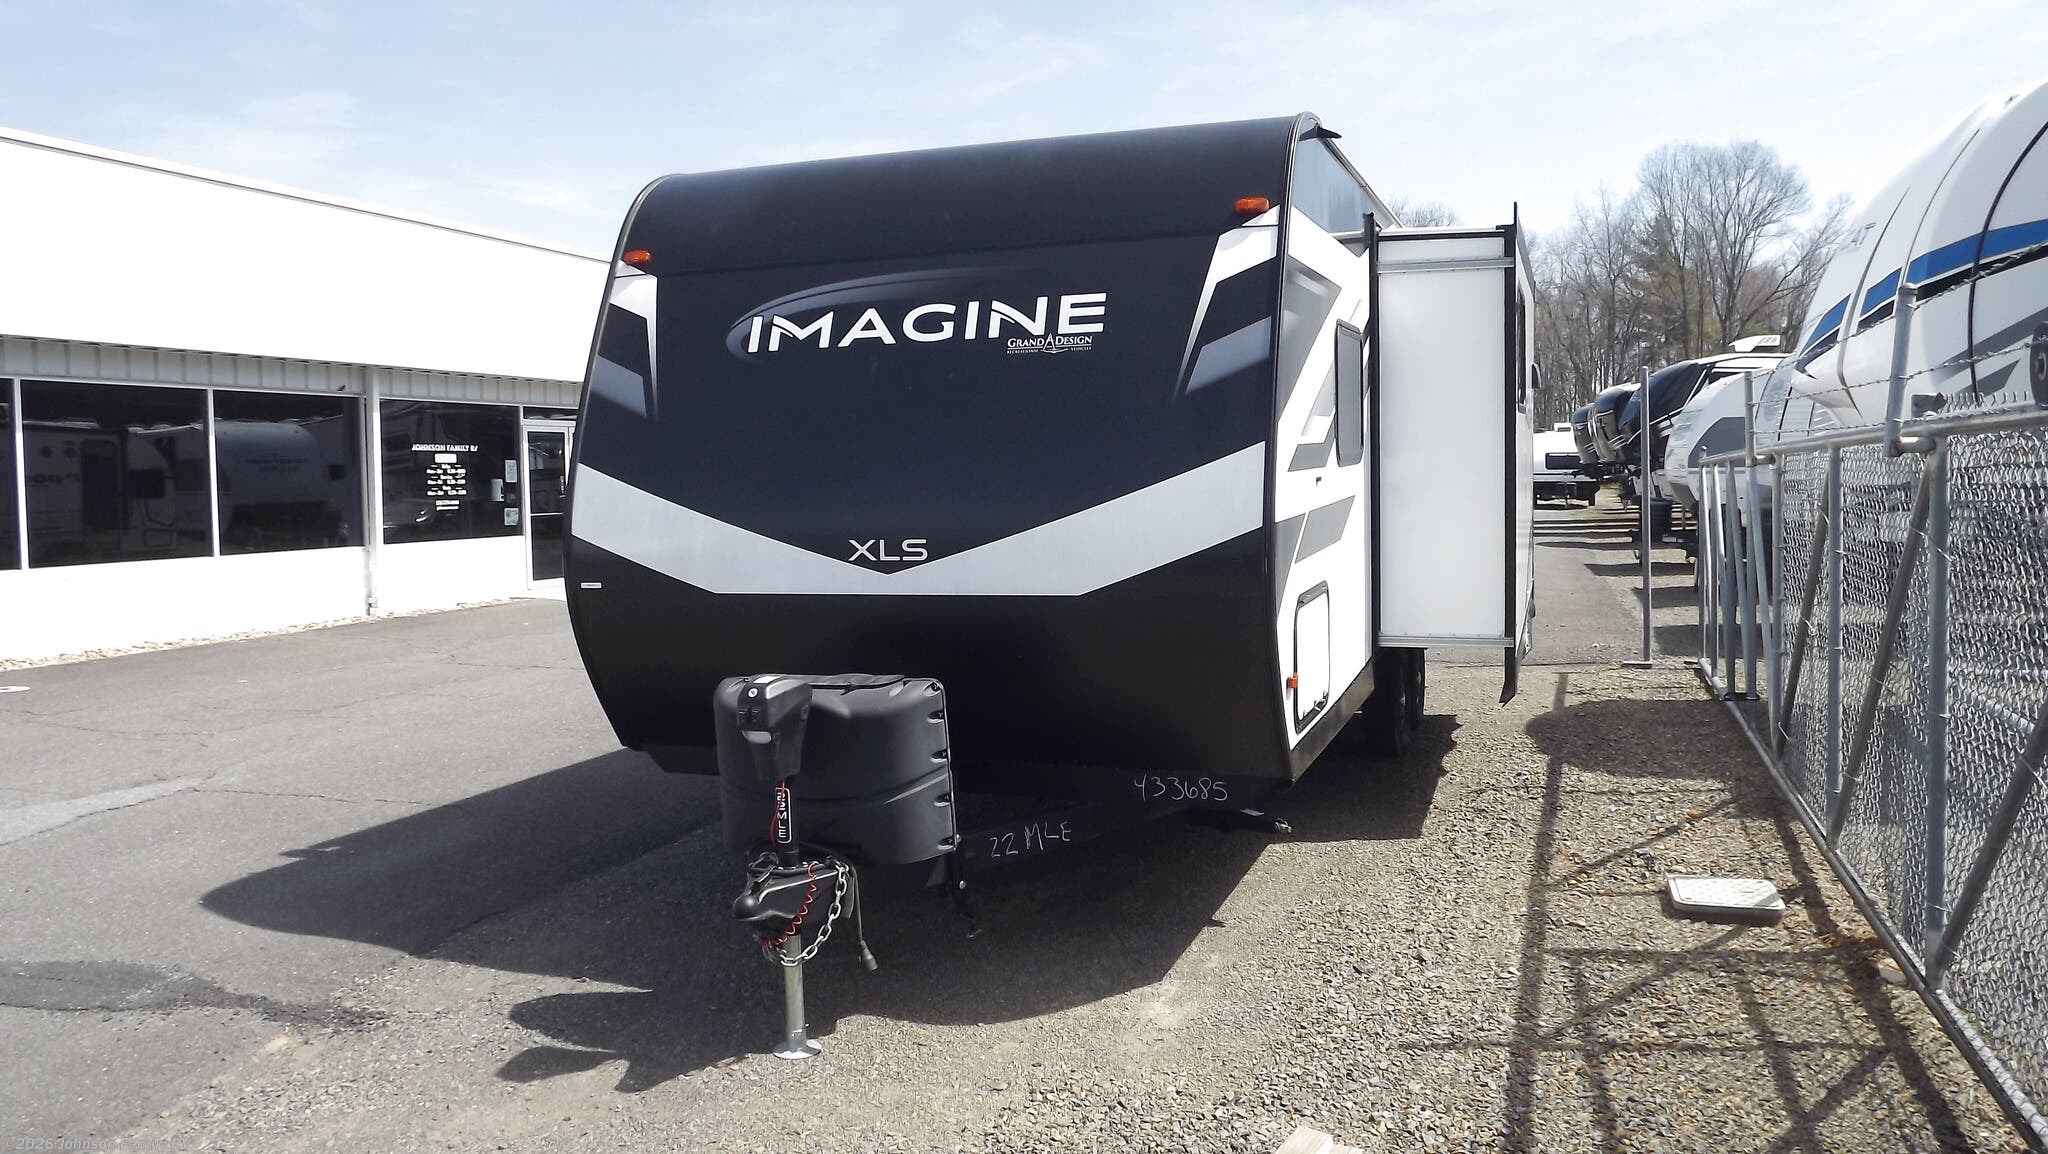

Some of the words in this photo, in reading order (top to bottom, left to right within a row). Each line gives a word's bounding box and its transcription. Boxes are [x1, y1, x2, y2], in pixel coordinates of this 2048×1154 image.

[747, 292, 1107, 353] IMAGINE
[1007, 338, 1045, 348] GRAND
[1055, 335, 1092, 345] DESIGN
[411, 444, 446, 452] JOHNSON
[446, 444, 470, 452] FAMILY
[847, 539, 928, 561] XLS
[1133, 773, 1228, 801] 433685
[989, 832, 1018, 857] 22
[1024, 821, 1072, 851] MLE
